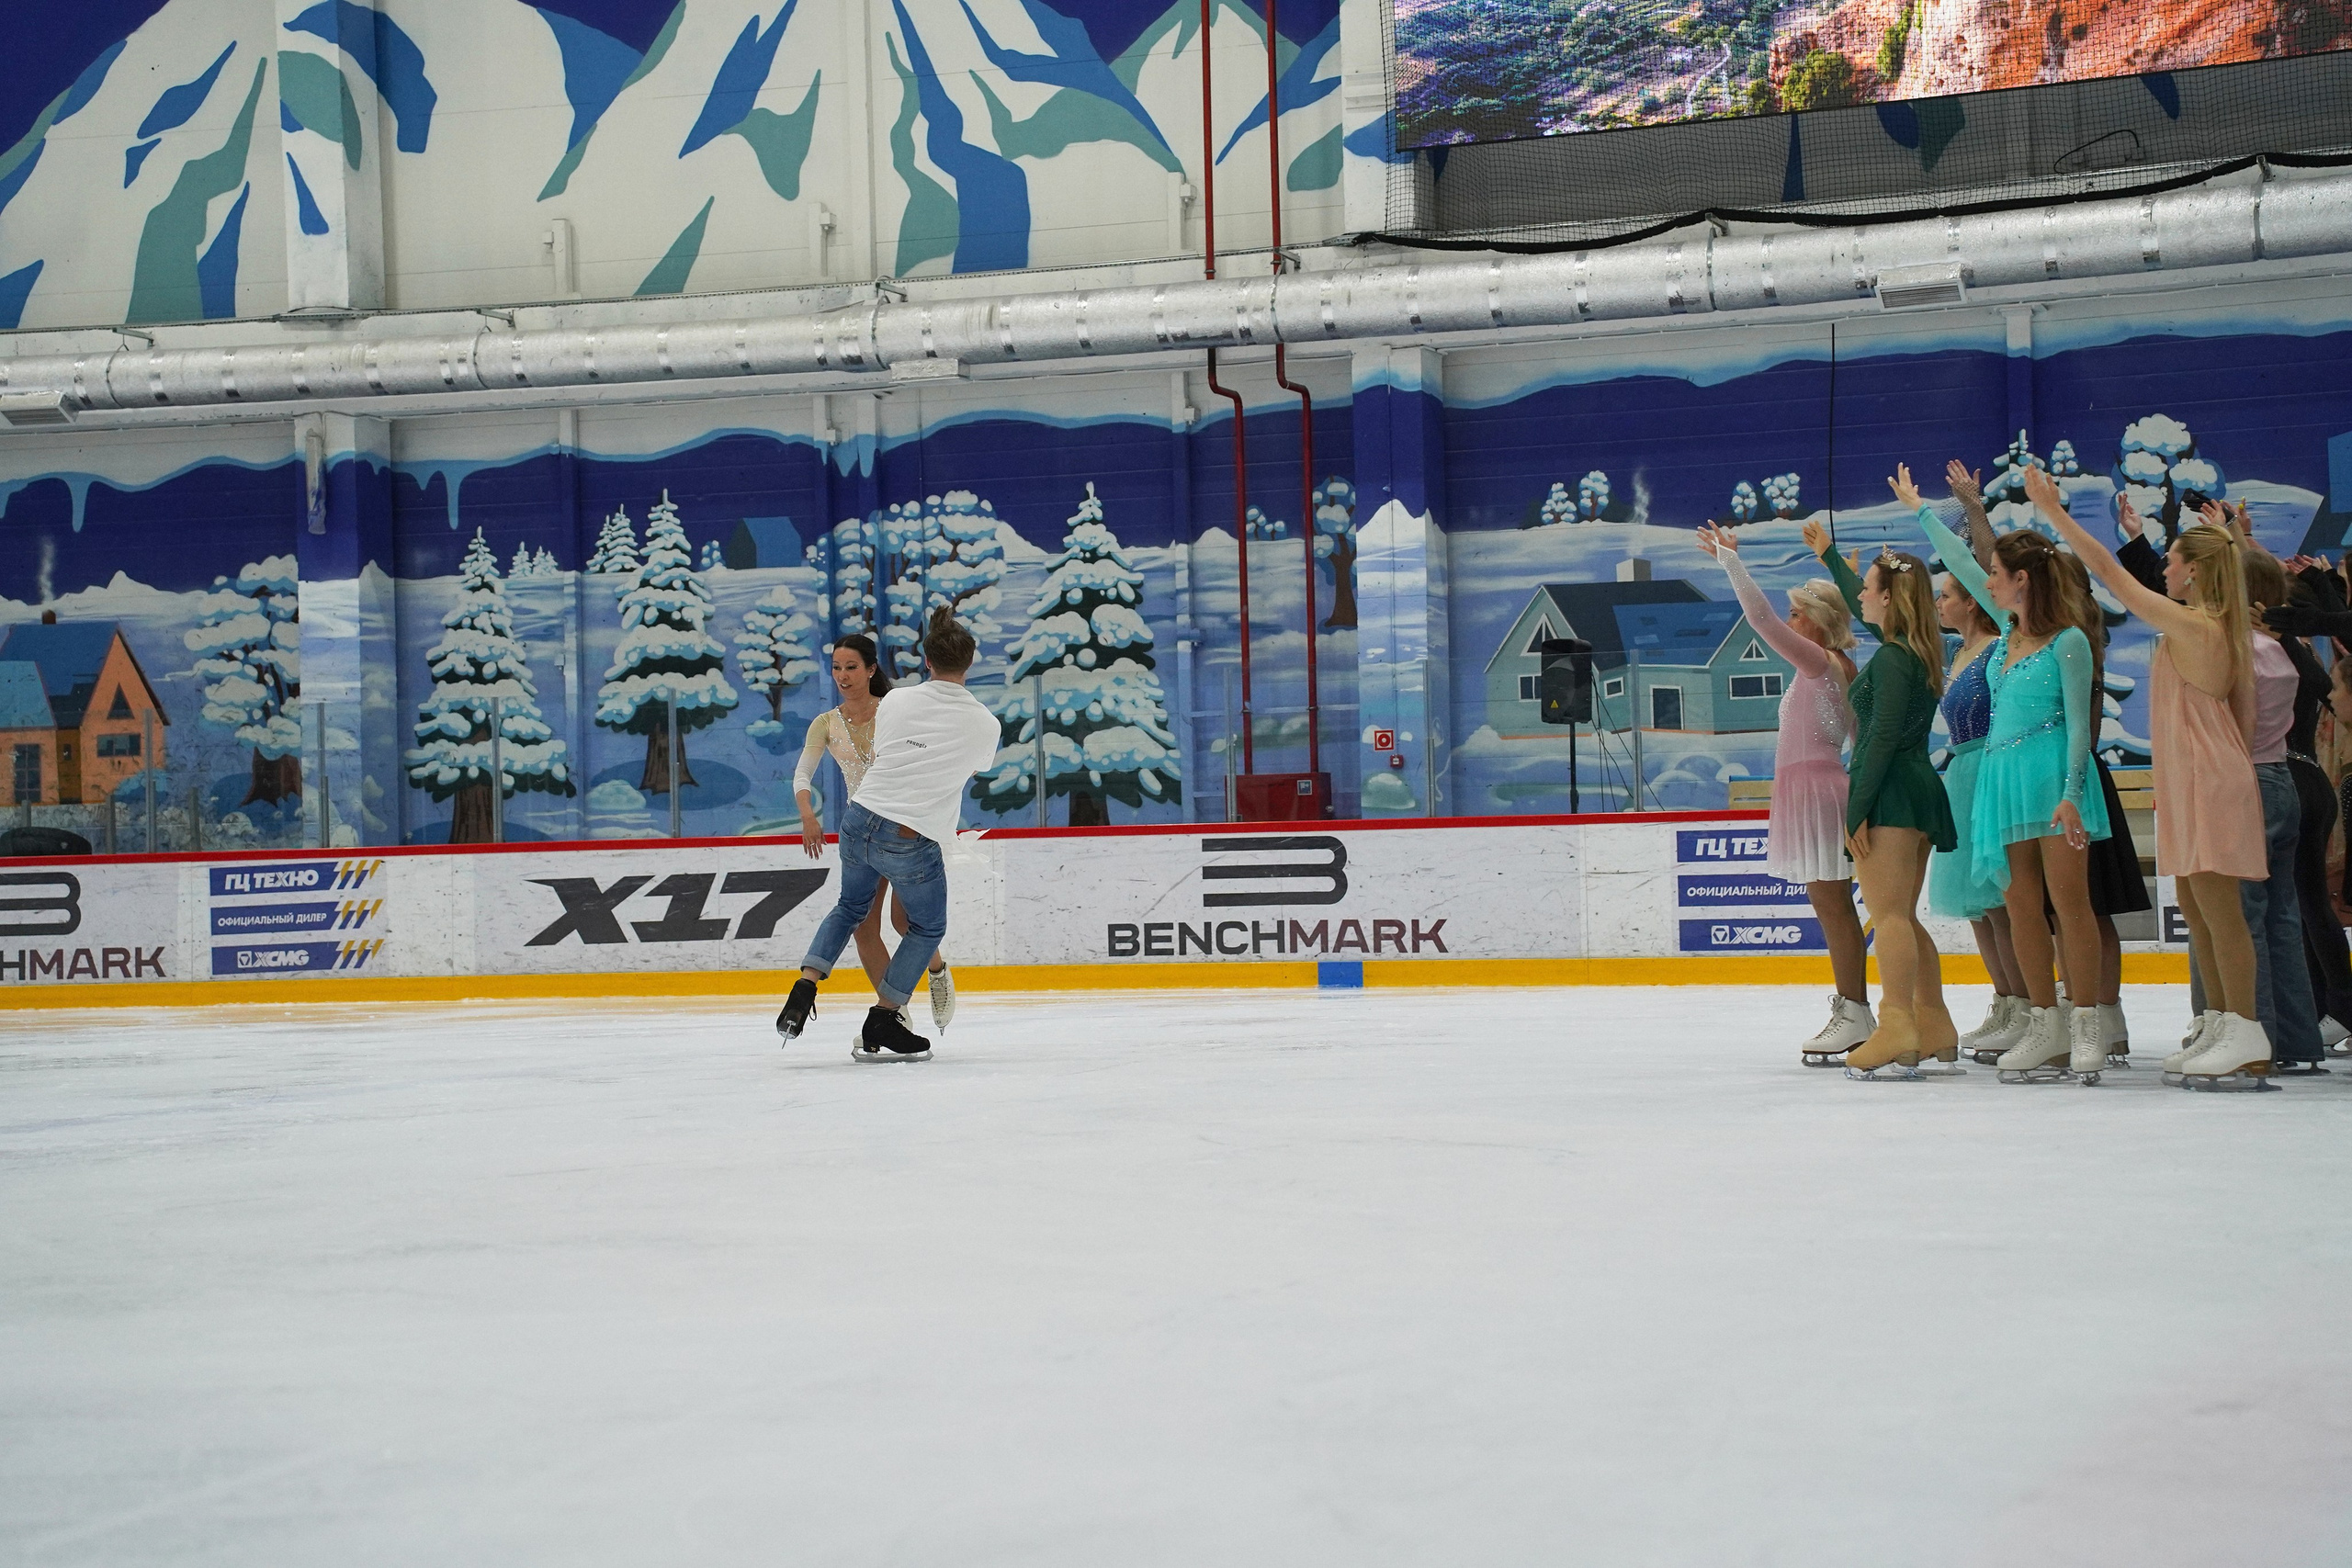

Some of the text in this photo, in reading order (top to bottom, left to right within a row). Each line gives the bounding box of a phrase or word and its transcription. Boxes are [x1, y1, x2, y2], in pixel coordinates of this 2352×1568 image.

[1696, 837, 1768, 858] ГЦ ТЕХ
[225, 869, 320, 892] ГЦ ТЕХНО
[1687, 883, 1808, 897] ОФИЦИАЛЬНЫЙ ДИЛ
[524, 867, 831, 947] X17
[218, 912, 327, 927] ОФИЦИАЛЬНЫЙ ДИЛЕР
[1108, 919, 1449, 957] BENCHMARK
[1729, 926, 1803, 944] XCMG
[0, 946, 166, 981] HMARK
[252, 950, 310, 967] XCMG
